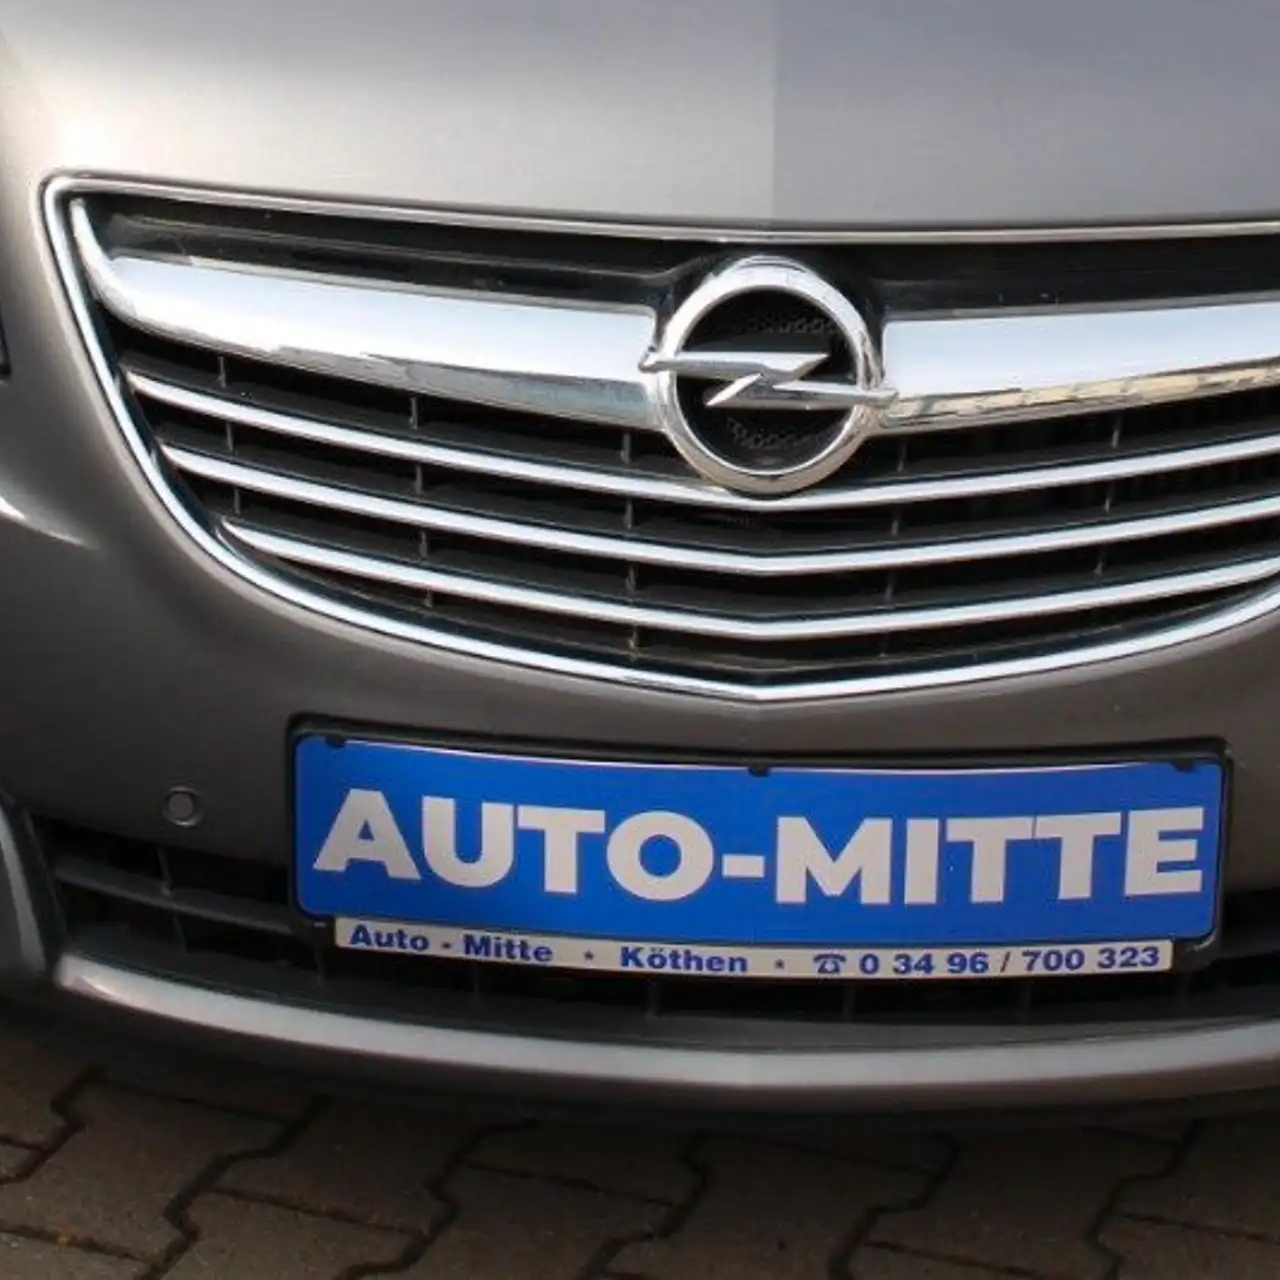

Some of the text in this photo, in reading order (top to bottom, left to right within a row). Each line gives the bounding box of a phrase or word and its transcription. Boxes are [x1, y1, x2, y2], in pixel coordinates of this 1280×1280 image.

[313, 788, 1204, 905] AUTO-MITTE
[348, 924, 430, 951] Auto
[463, 933, 554, 962] Mitte
[621, 945, 748, 974] Köthen
[859, 953, 880, 975] 0
[892, 952, 934, 975] 34
[947, 951, 989, 974] 96
[1021, 948, 1085, 972] 700
[1098, 946, 1160, 970] 323
